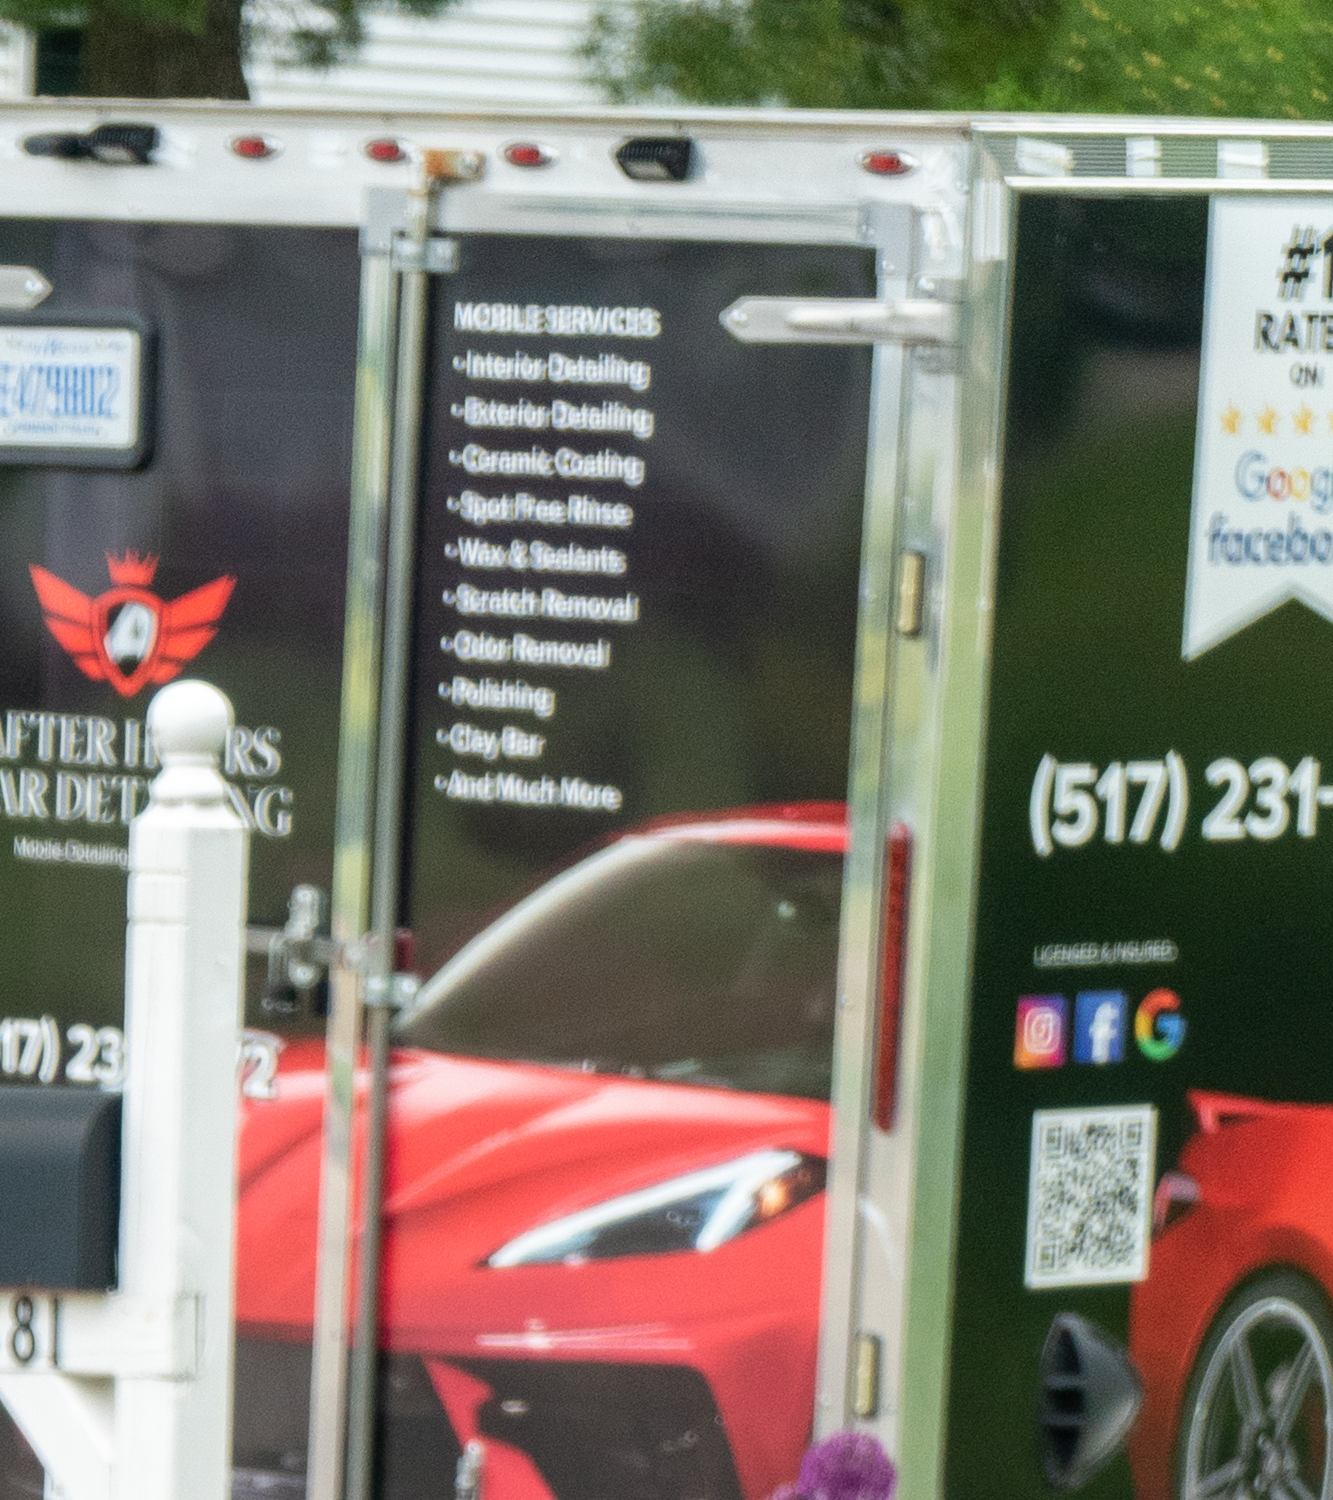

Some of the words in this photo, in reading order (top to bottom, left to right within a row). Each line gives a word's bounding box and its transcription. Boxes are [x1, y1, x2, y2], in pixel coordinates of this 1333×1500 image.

[454, 302, 544, 334] MOBILE
[545, 305, 661, 337] SERVICES
[466, 350, 547, 381] Interior
[548, 352, 651, 391] Detailing
[1289, 362, 1323, 389] ON
[464, 396, 551, 428] Exterior
[552, 400, 654, 439] Detailing
[463, 444, 555, 476] Ceramic
[555, 447, 645, 486] Coating
[460, 490, 515, 525] Spot
[515, 492, 568, 523] Free
[568, 494, 634, 527] Rinse
[458, 537, 507, 568] Wax
[507, 538, 529, 570] &
[530, 540, 628, 575] Sealants
[456, 583, 541, 616] Scratch
[542, 588, 639, 622] Removal
[454, 630, 512, 662] Odor
[512, 634, 611, 669] Removal
[452, 676, 556, 718] Polishing
[125, 718, 282, 777] HRS
[449, 723, 501, 761] Clay
[501, 726, 546, 758] Bar
[56, 771, 293, 837] DETNG
[447, 769, 495, 801] And
[496, 772, 560, 804] Much
[560, 776, 623, 811] More
[1029, 749, 1189, 858] (517)
[14, 836, 63, 861] Mobile
